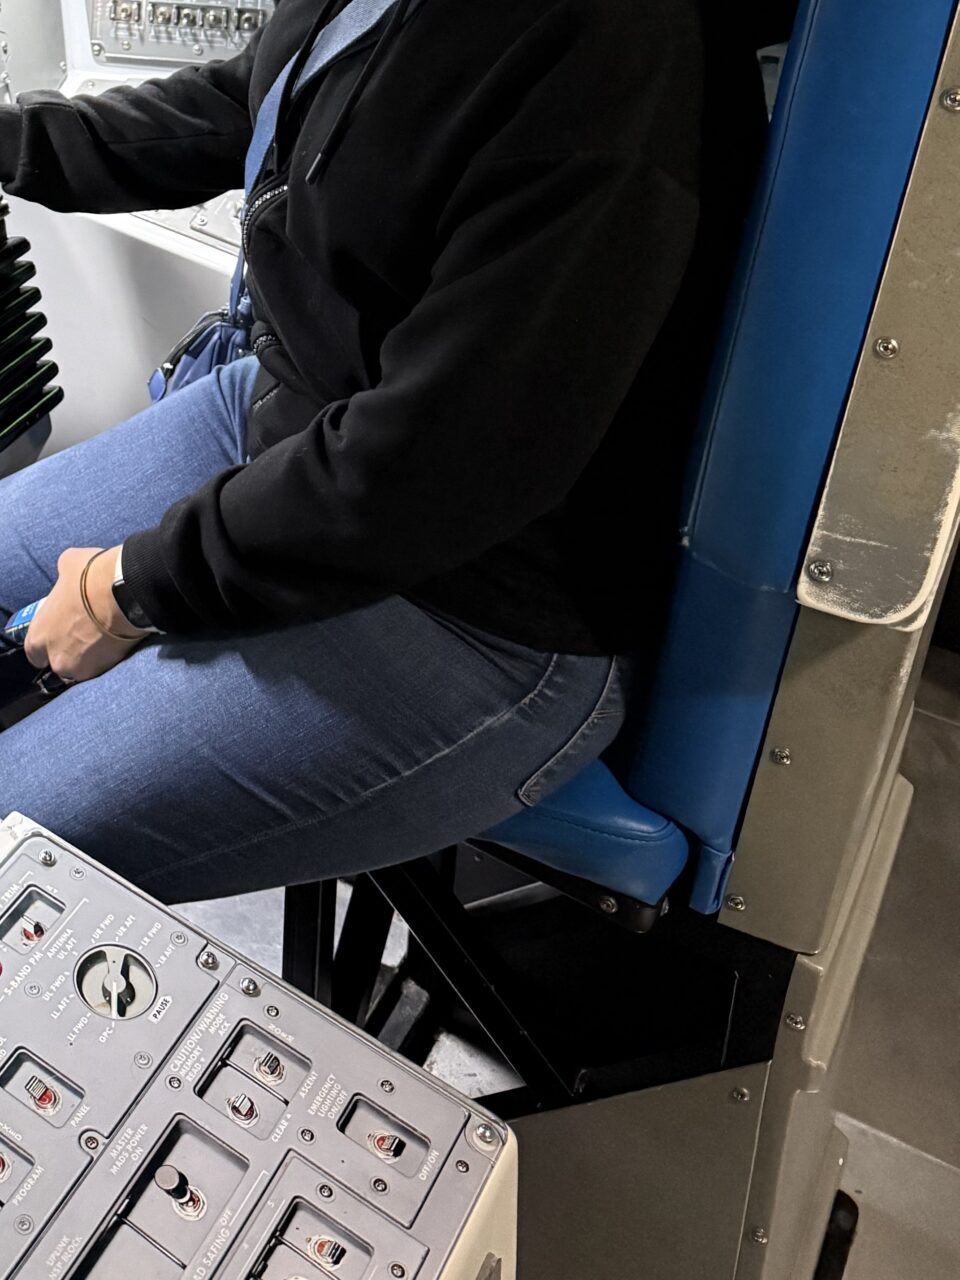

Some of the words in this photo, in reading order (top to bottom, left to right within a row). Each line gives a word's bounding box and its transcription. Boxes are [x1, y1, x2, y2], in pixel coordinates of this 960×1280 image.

[0, 883, 21, 904] TRIM
[93, 927, 103, 940] UR
[100, 913, 115, 930] FWD
[46, 927, 75, 959] ANTENNA
[3, 964, 33, 997] S-BAND
[28, 951, 45, 967] PM
[42, 990, 53, 1002] UL
[50, 974, 66, 992] FWD
[152, 997, 171, 1021] PAUSE
[208, 1012, 227, 1035] MODE
[66, 1029, 76, 1042] LL
[72, 1014, 89, 1032] FWD
[170, 991, 230, 1073] CAUTION/WARNING
[217, 1021, 232, 1036] ACK
[179, 1045, 204, 1080] MEMORY
[186, 1060, 202, 1083] READ
[298, 1070, 319, 1100] ASCENT
[307, 1072, 338, 1116] EMERGENCY
[317, 1083, 342, 1118] LIGHTING
[327, 1090, 350, 1120] ON/OFF
[109, 1127, 136, 1159] MASTER
[271, 1120, 289, 1143] CLEAR
[110, 1150, 131, 1176] MADS
[127, 1123, 149, 1153] POWER
[418, 1149, 440, 1182] OFF/ON
[11, 1165, 45, 1206] PROGRAM
[204, 1225, 231, 1267] SAFING
